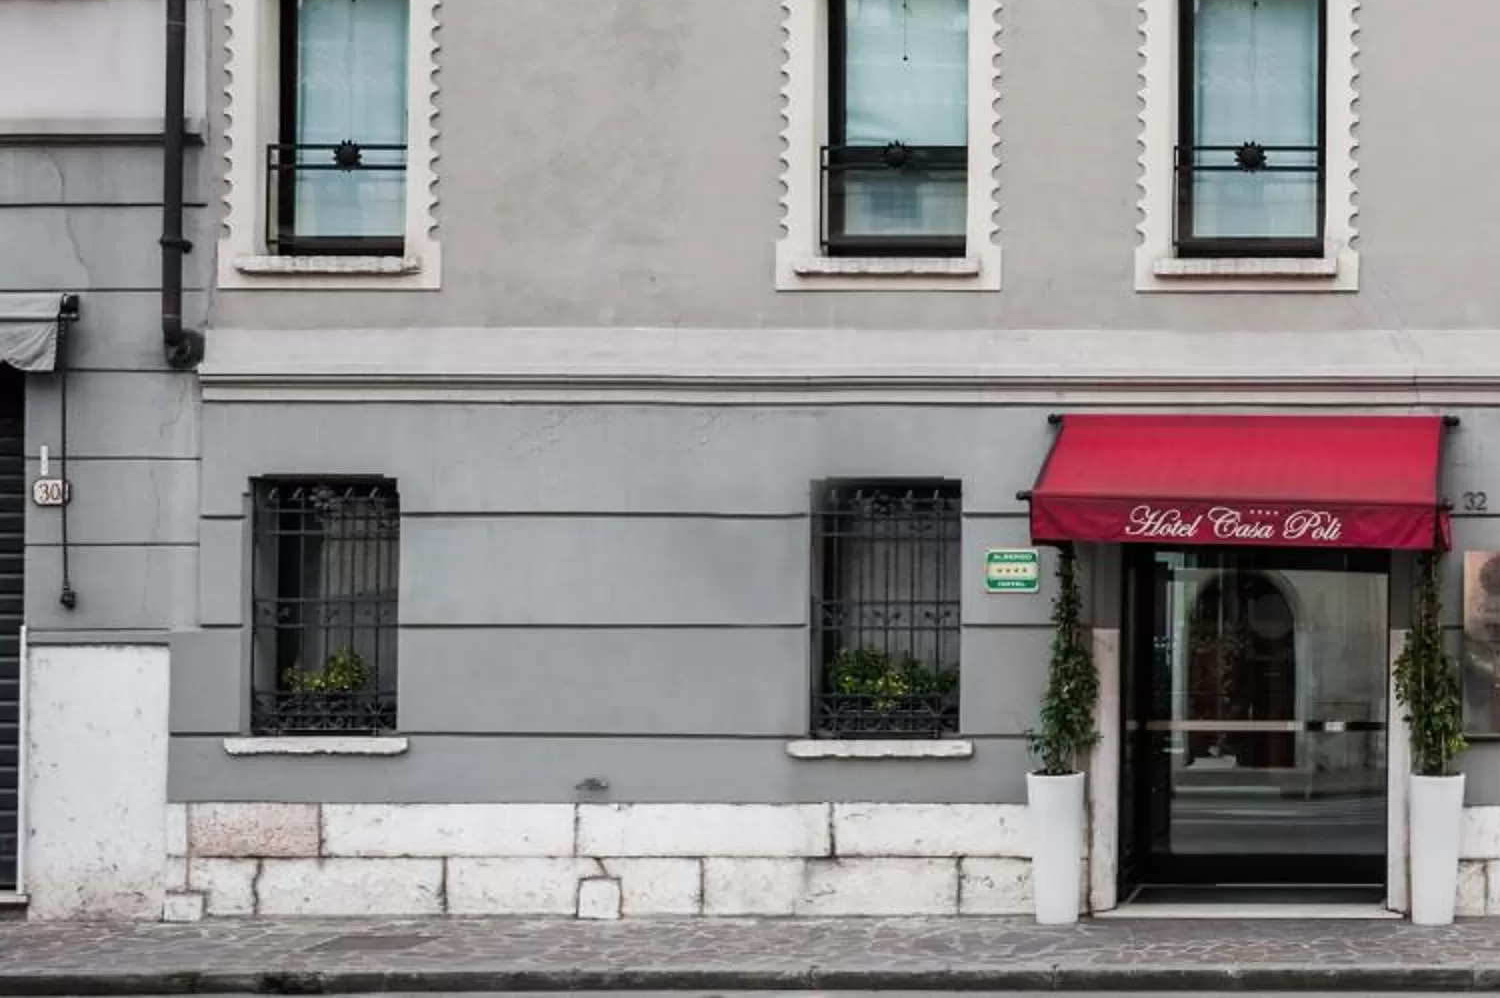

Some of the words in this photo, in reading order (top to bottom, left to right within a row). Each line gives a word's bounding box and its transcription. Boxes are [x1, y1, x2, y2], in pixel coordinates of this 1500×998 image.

[39, 483, 61, 502] 30
[1462, 490, 1488, 511] 32
[1125, 505, 1202, 538] Hotel
[1207, 506, 1274, 539] Casa
[1282, 509, 1342, 541] Poli
